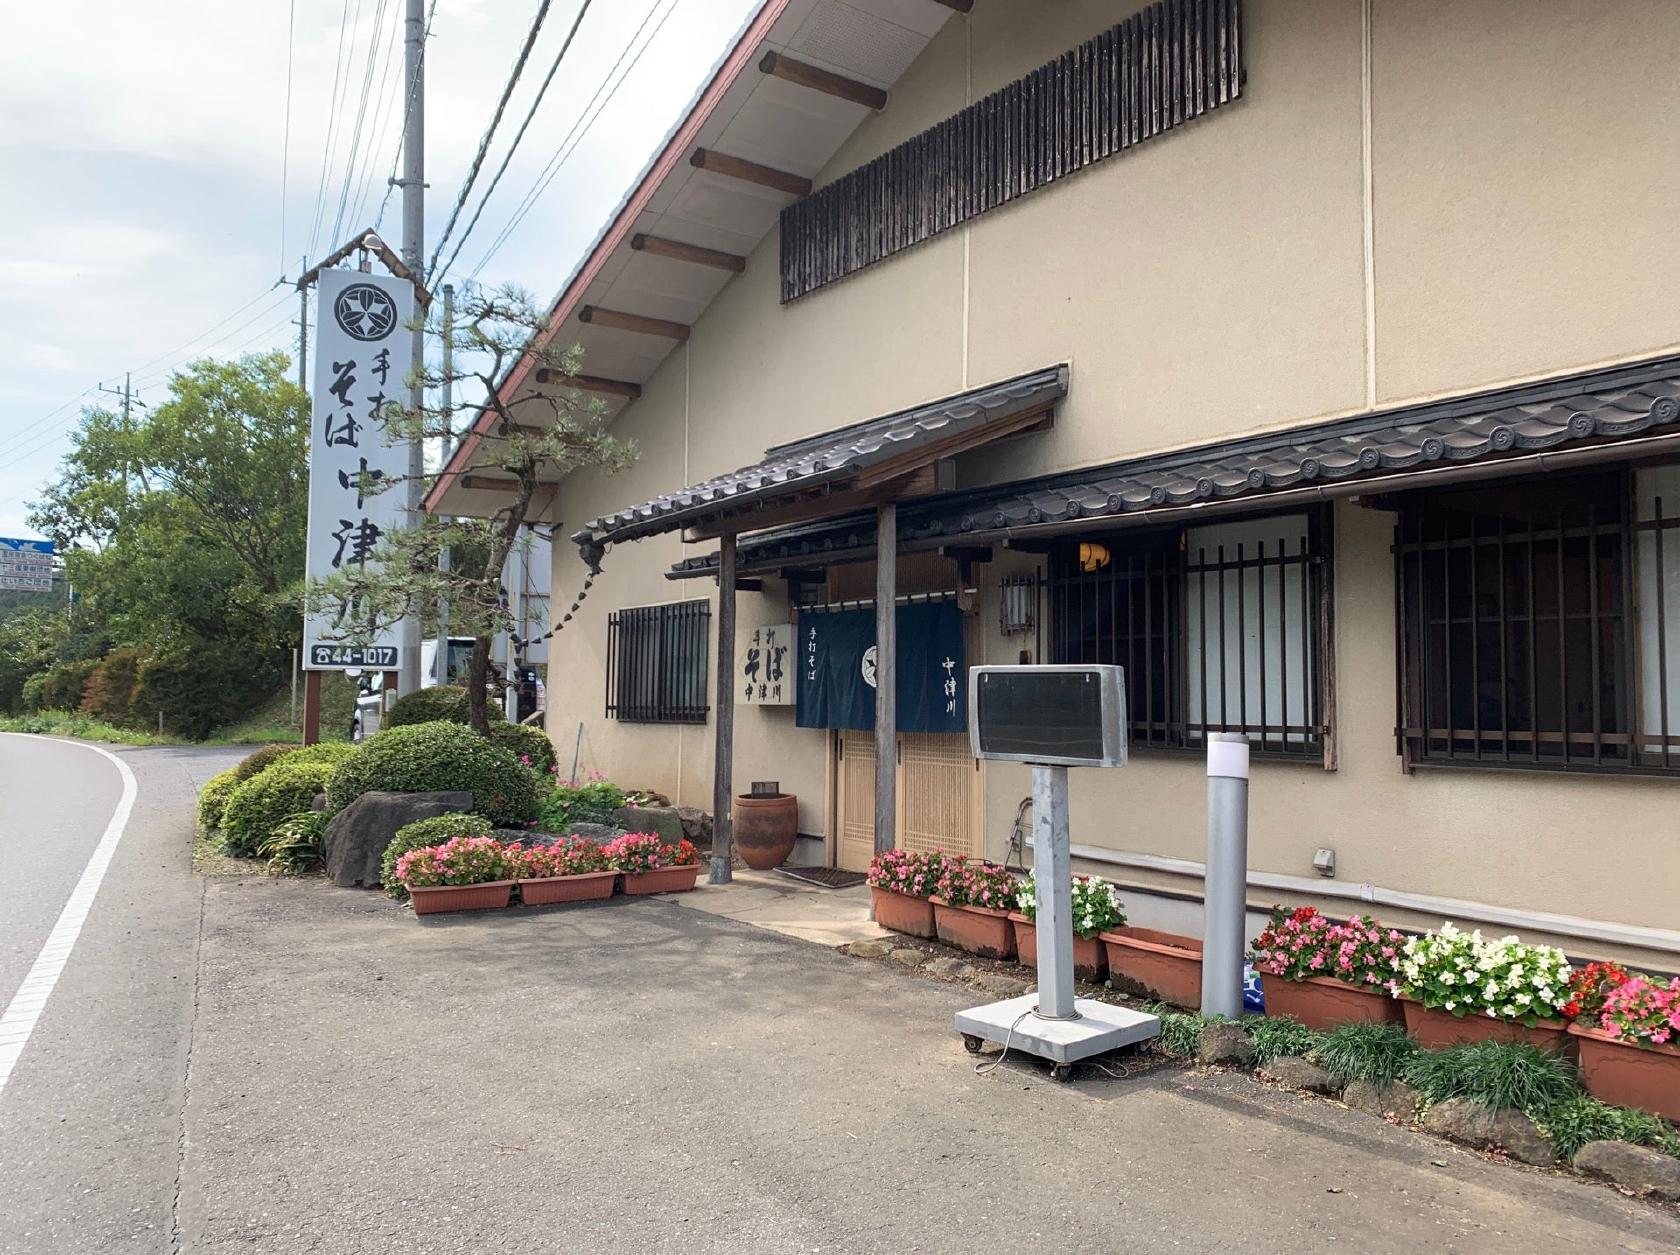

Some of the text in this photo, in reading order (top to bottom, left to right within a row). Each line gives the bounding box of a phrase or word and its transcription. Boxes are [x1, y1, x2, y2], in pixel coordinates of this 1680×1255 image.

[325, 360, 363, 448] そば
[332, 647, 393, 664] 44-1017
[744, 645, 787, 684] そば
[807, 626, 817, 681] 手打そば
[744, 683, 781, 703] 中津川
[942, 656, 958, 718] 中津川
